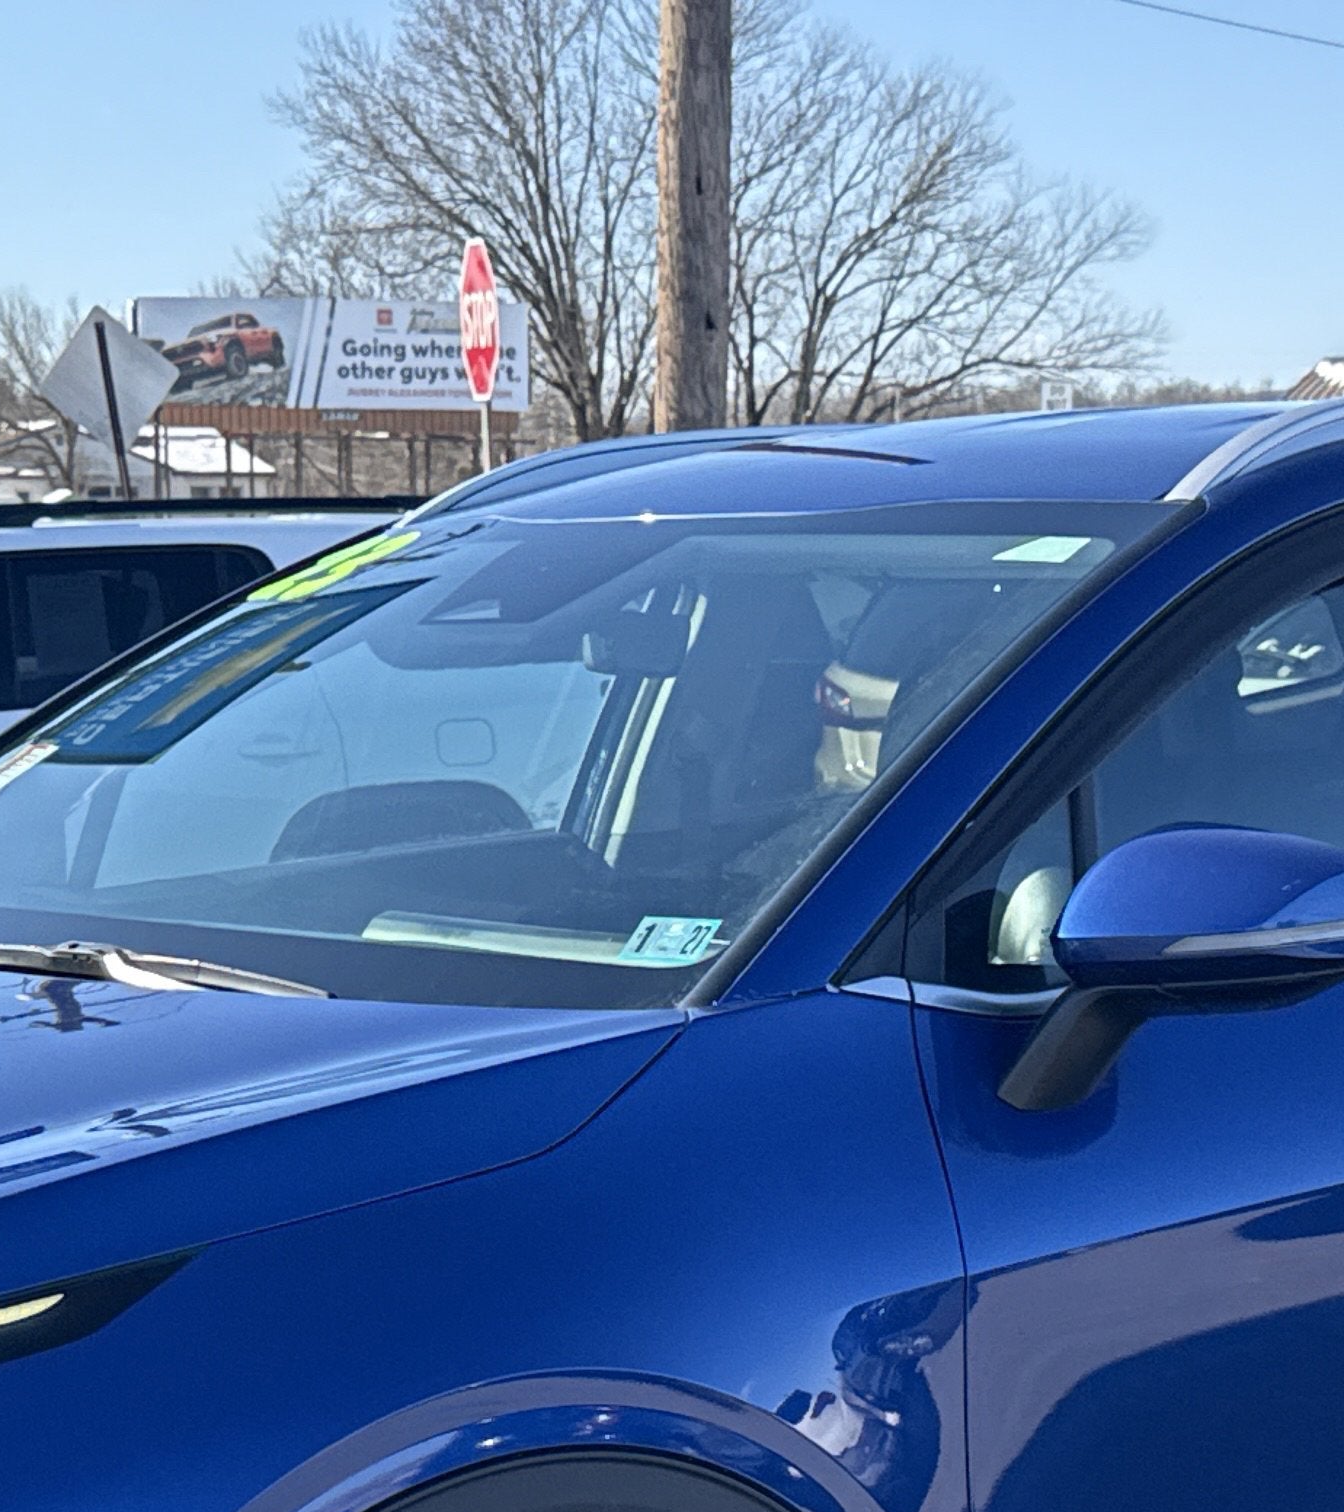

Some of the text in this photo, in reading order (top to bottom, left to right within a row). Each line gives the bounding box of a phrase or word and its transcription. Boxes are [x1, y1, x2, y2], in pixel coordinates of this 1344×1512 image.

[462, 291, 498, 348] STOP
[342, 338, 406, 362] Going
[337, 360, 397, 380] other
[400, 366, 450, 384] guys
[679, 925, 712, 955] 27
